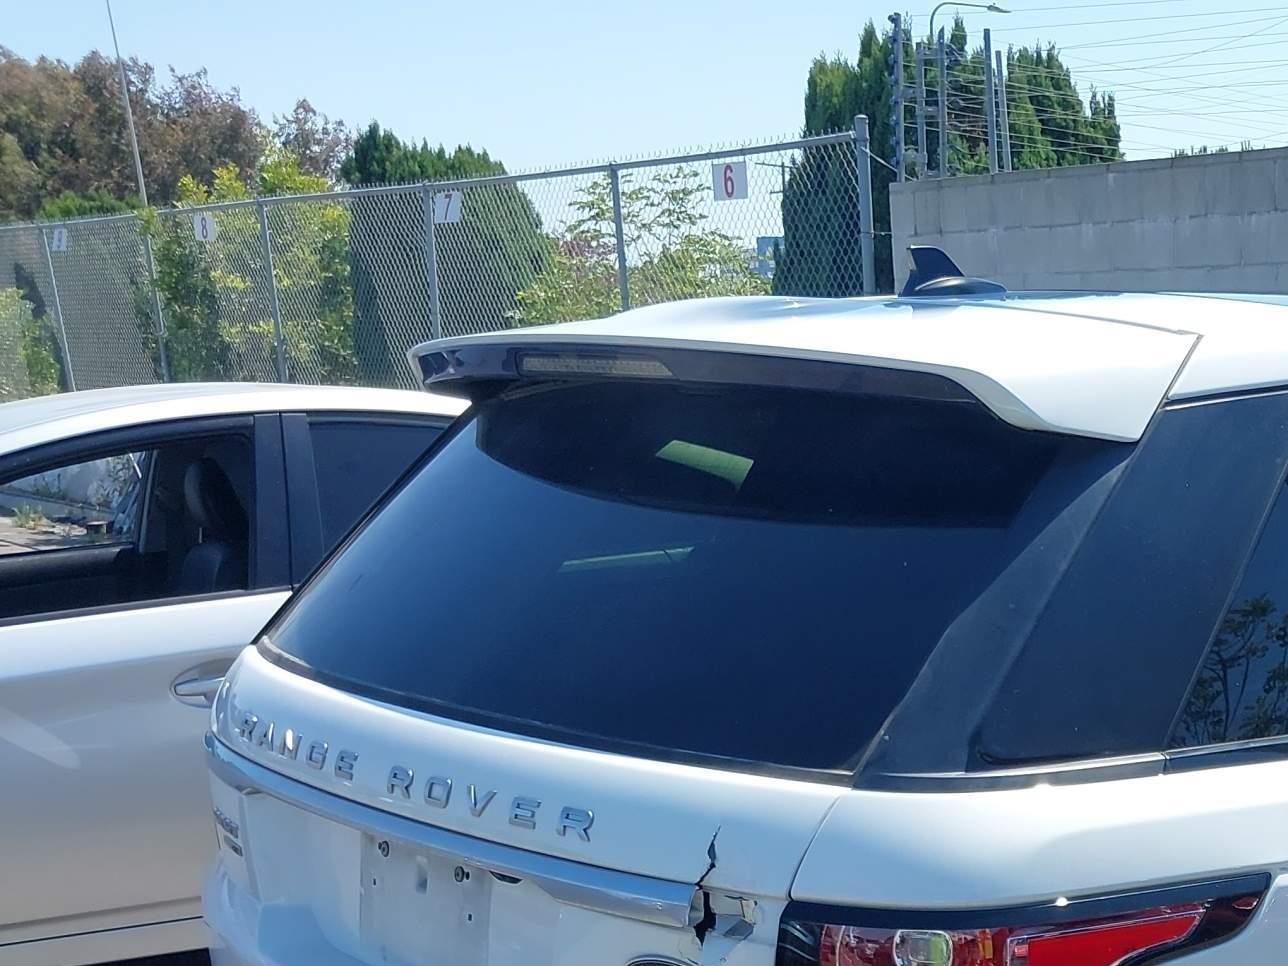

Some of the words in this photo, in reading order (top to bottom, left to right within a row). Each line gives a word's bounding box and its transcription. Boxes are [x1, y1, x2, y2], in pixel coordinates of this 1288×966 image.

[724, 164, 734, 198] 6
[444, 193, 453, 221] 7
[201, 216, 208, 239] 8
[239, 713, 358, 781] RANGE
[386, 766, 595, 841] ROVER
